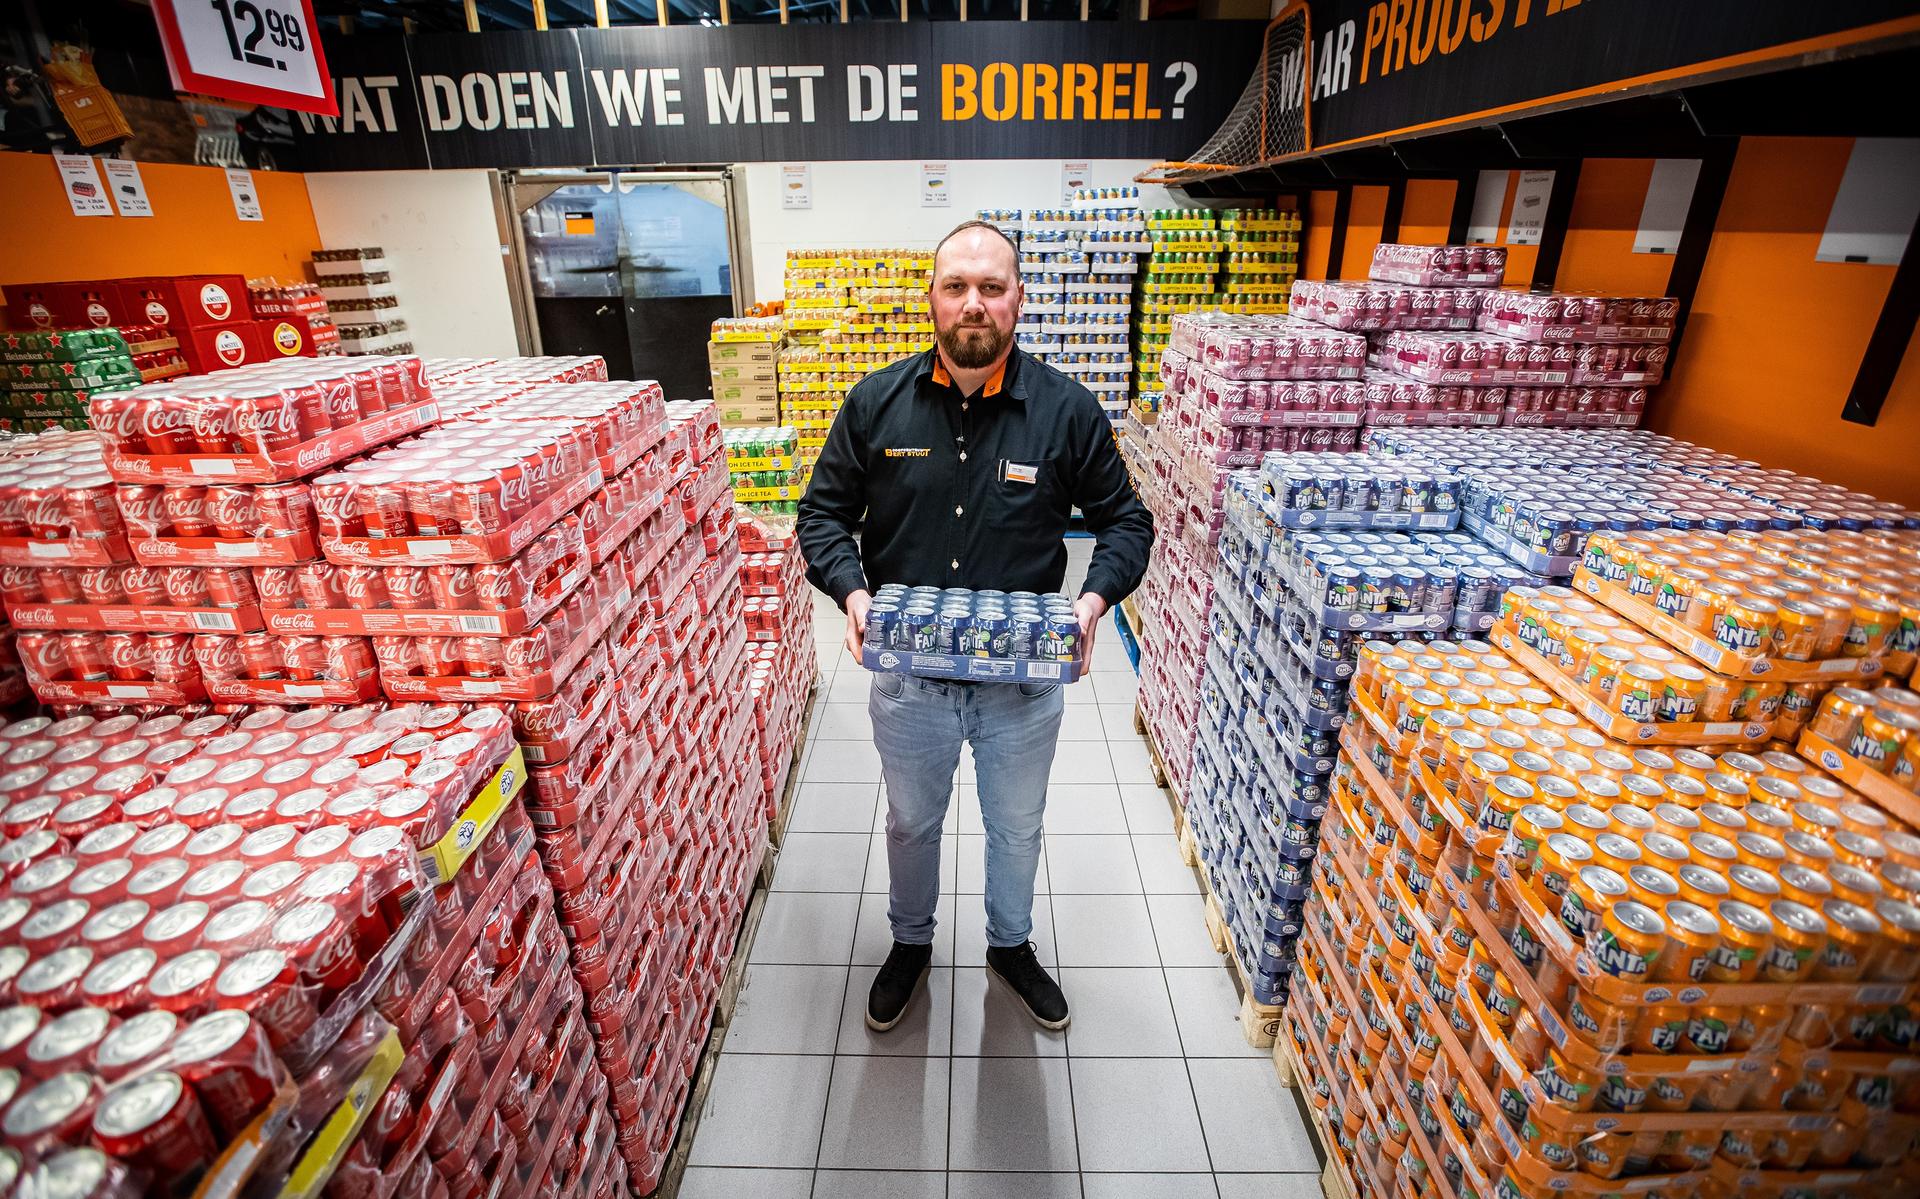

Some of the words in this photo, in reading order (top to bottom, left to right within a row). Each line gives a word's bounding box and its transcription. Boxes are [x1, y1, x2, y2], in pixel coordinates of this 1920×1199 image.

[420, 71, 574, 131] DOEN
[591, 67, 685, 127] WE
[704, 65, 824, 125] MET
[847, 63, 918, 122] DE
[941, 61, 1198, 121] BORREL?
[1544, 328, 1574, 339] Coca-Cola
[4, 352, 44, 360] Heineken
[1441, 372, 1472, 382] Coca-Cola
[1231, 413, 1261, 424] Coca-Cola
[1376, 414, 1406, 424] Coca-Cola
[1514, 413, 1544, 424] Coca-Cola
[1227, 454, 1256, 464] Coca-Cola
[13, 608, 56, 624] Coca-Cola
[271, 613, 315, 628] Coca-Cola
[1716, 624, 1761, 648] FANTA
[1036, 639, 1068, 654] FANTA
